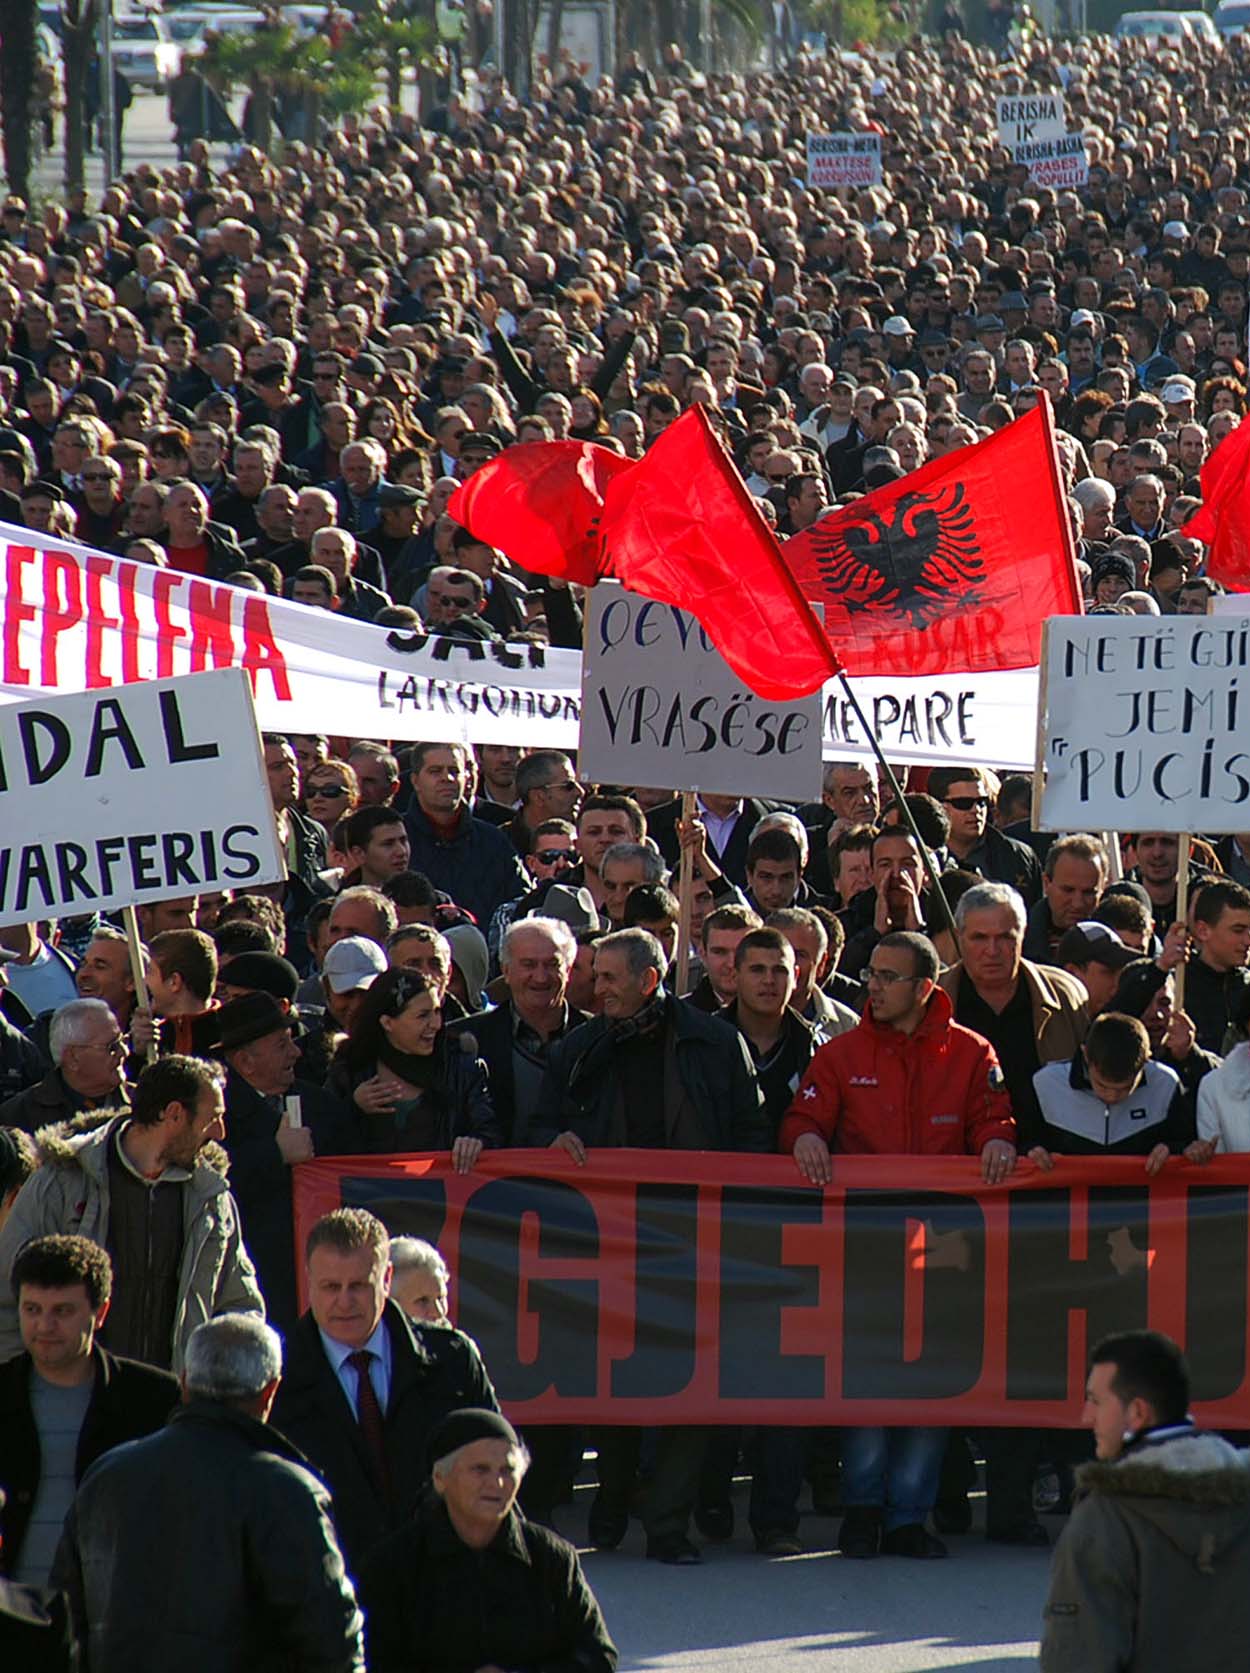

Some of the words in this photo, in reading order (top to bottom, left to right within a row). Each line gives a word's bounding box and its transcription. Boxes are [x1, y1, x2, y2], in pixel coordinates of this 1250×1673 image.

[1001, 101, 1057, 122] BERISHA
[1016, 122, 1037, 142] IK
[1065, 636, 1118, 678] NE
[1129, 627, 1176, 671] TË
[598, 685, 810, 756] VRASËSE
[872, 691, 976, 748] PARE
[1104, 678, 1239, 738] JEMI
[0, 689, 220, 792] DAL
